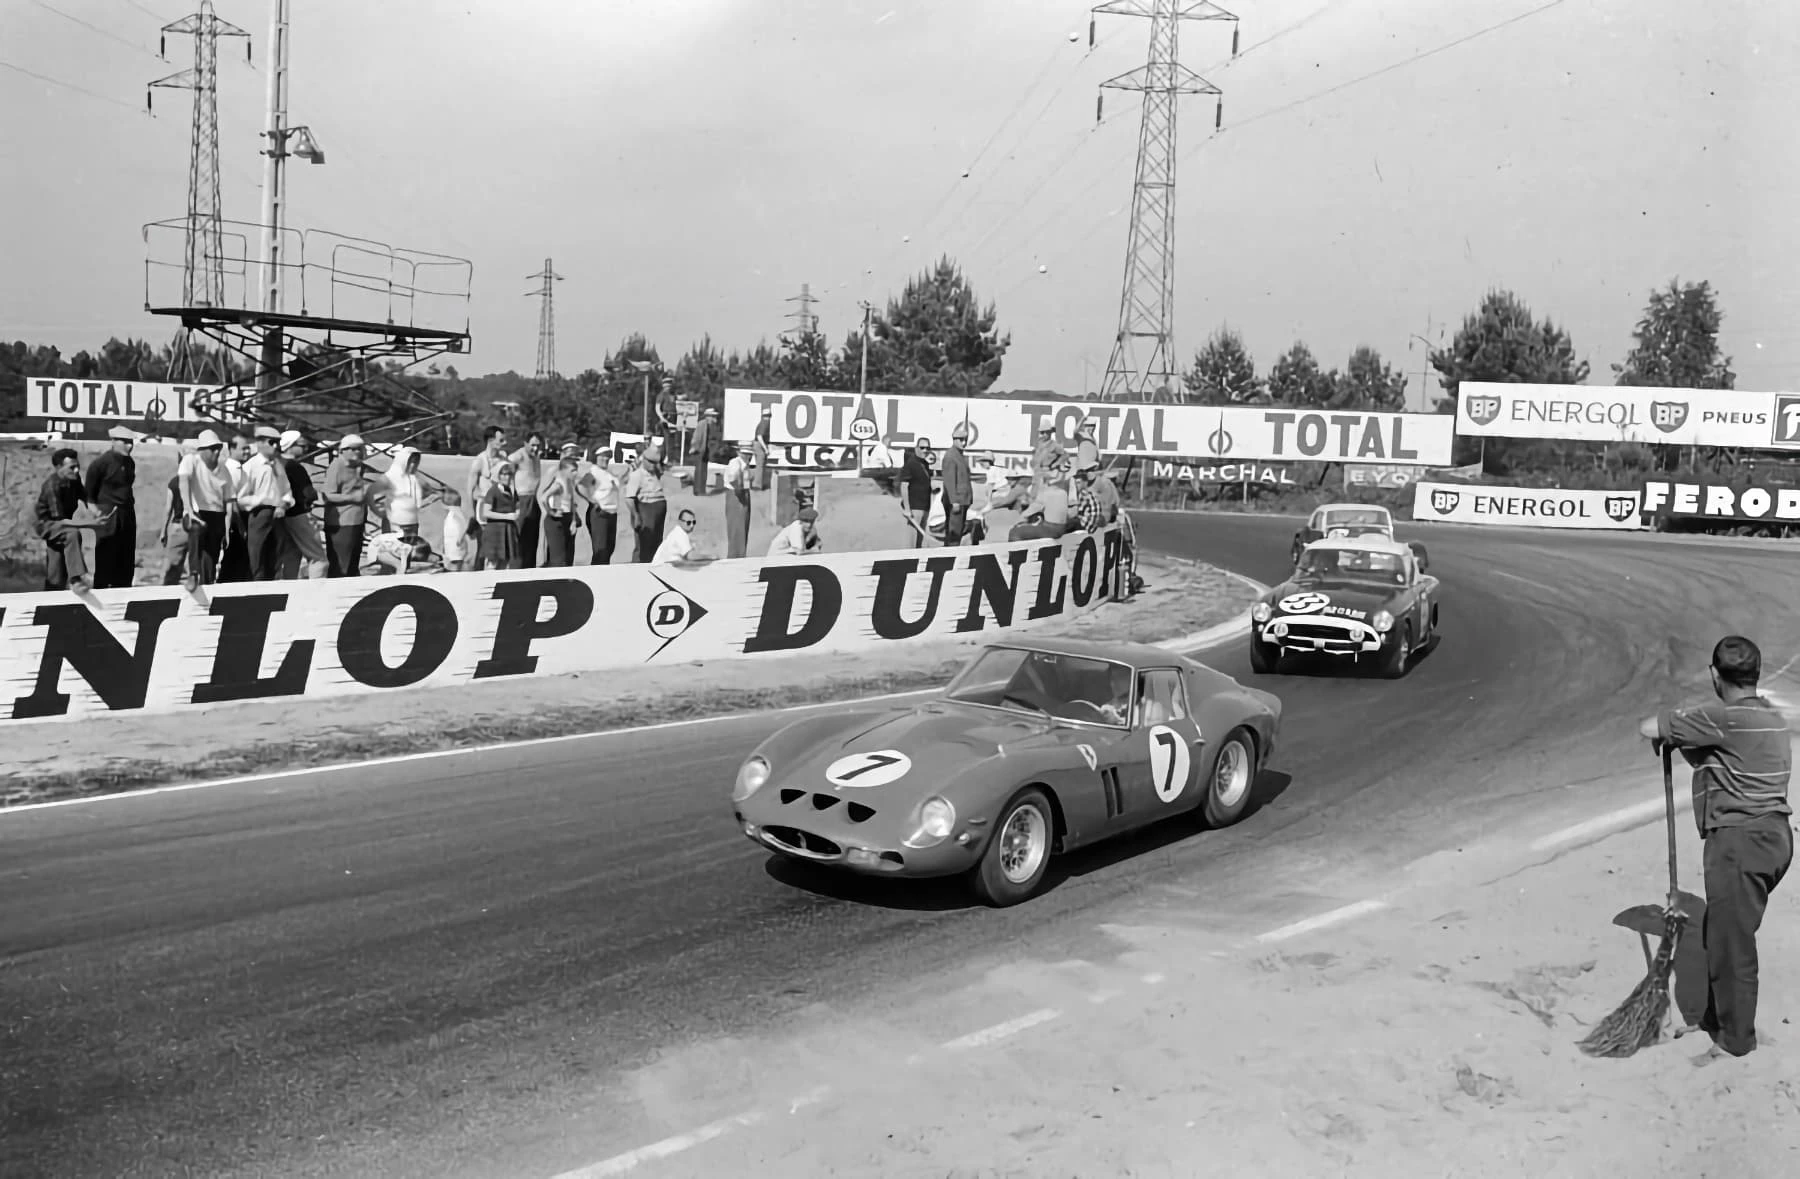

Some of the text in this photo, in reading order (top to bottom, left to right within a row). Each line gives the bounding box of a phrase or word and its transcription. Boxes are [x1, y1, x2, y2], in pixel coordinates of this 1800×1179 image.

[36, 380, 144, 416] TOTAL
[1469, 398, 1499, 420] BP
[1511, 399, 1642, 426] ENERGOL
[1654, 403, 1686, 427] BP
[1703, 410, 1767, 424] PNEUS
[750, 393, 914, 442] TOTAL
[1021, 404, 1178, 451] TOTAL
[1264, 412, 1418, 459] TOTAL
[766, 445, 874, 468] UCA
[1153, 460, 1296, 484] MARCHAL
[1433, 492, 1635, 518] BP ENERGOL BP
[0, 528, 1121, 720] NLOP D DUNLOP
[835, 754, 902, 781] 7
[1154, 732, 1177, 793] 7
